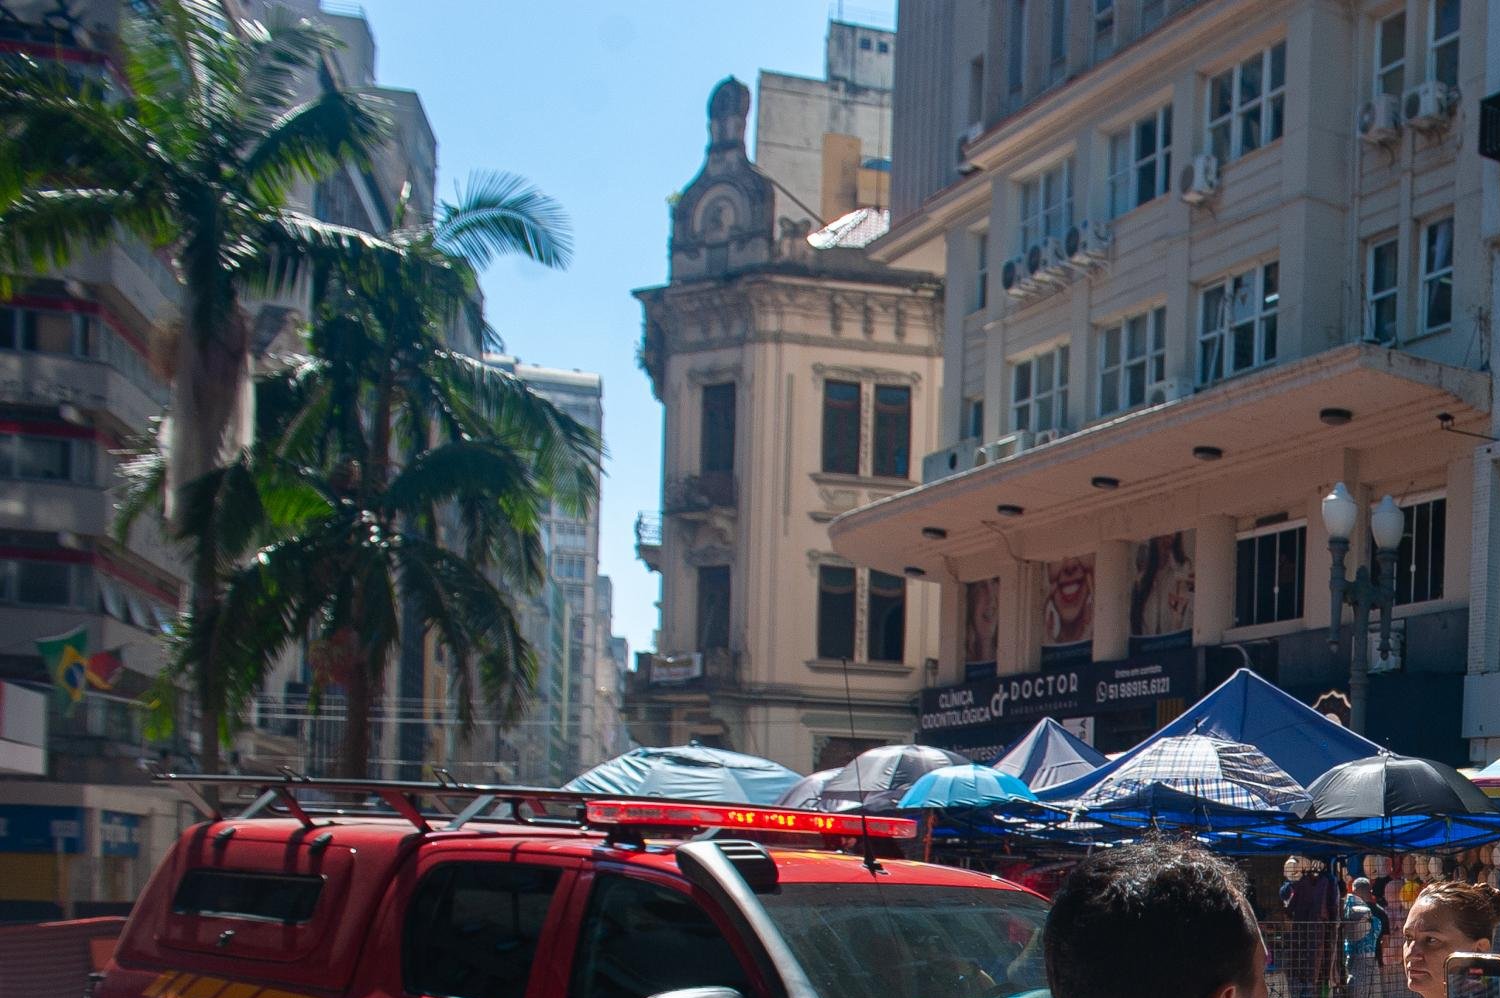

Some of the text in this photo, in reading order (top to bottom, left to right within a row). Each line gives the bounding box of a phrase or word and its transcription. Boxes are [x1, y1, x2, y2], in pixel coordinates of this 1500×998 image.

[1010, 672, 1079, 701] DOCTOR
[1109, 684, 1118, 699] 51
[939, 688, 974, 708] CLÍNICA
[921, 706, 991, 729] ODONTOLÓGICA
